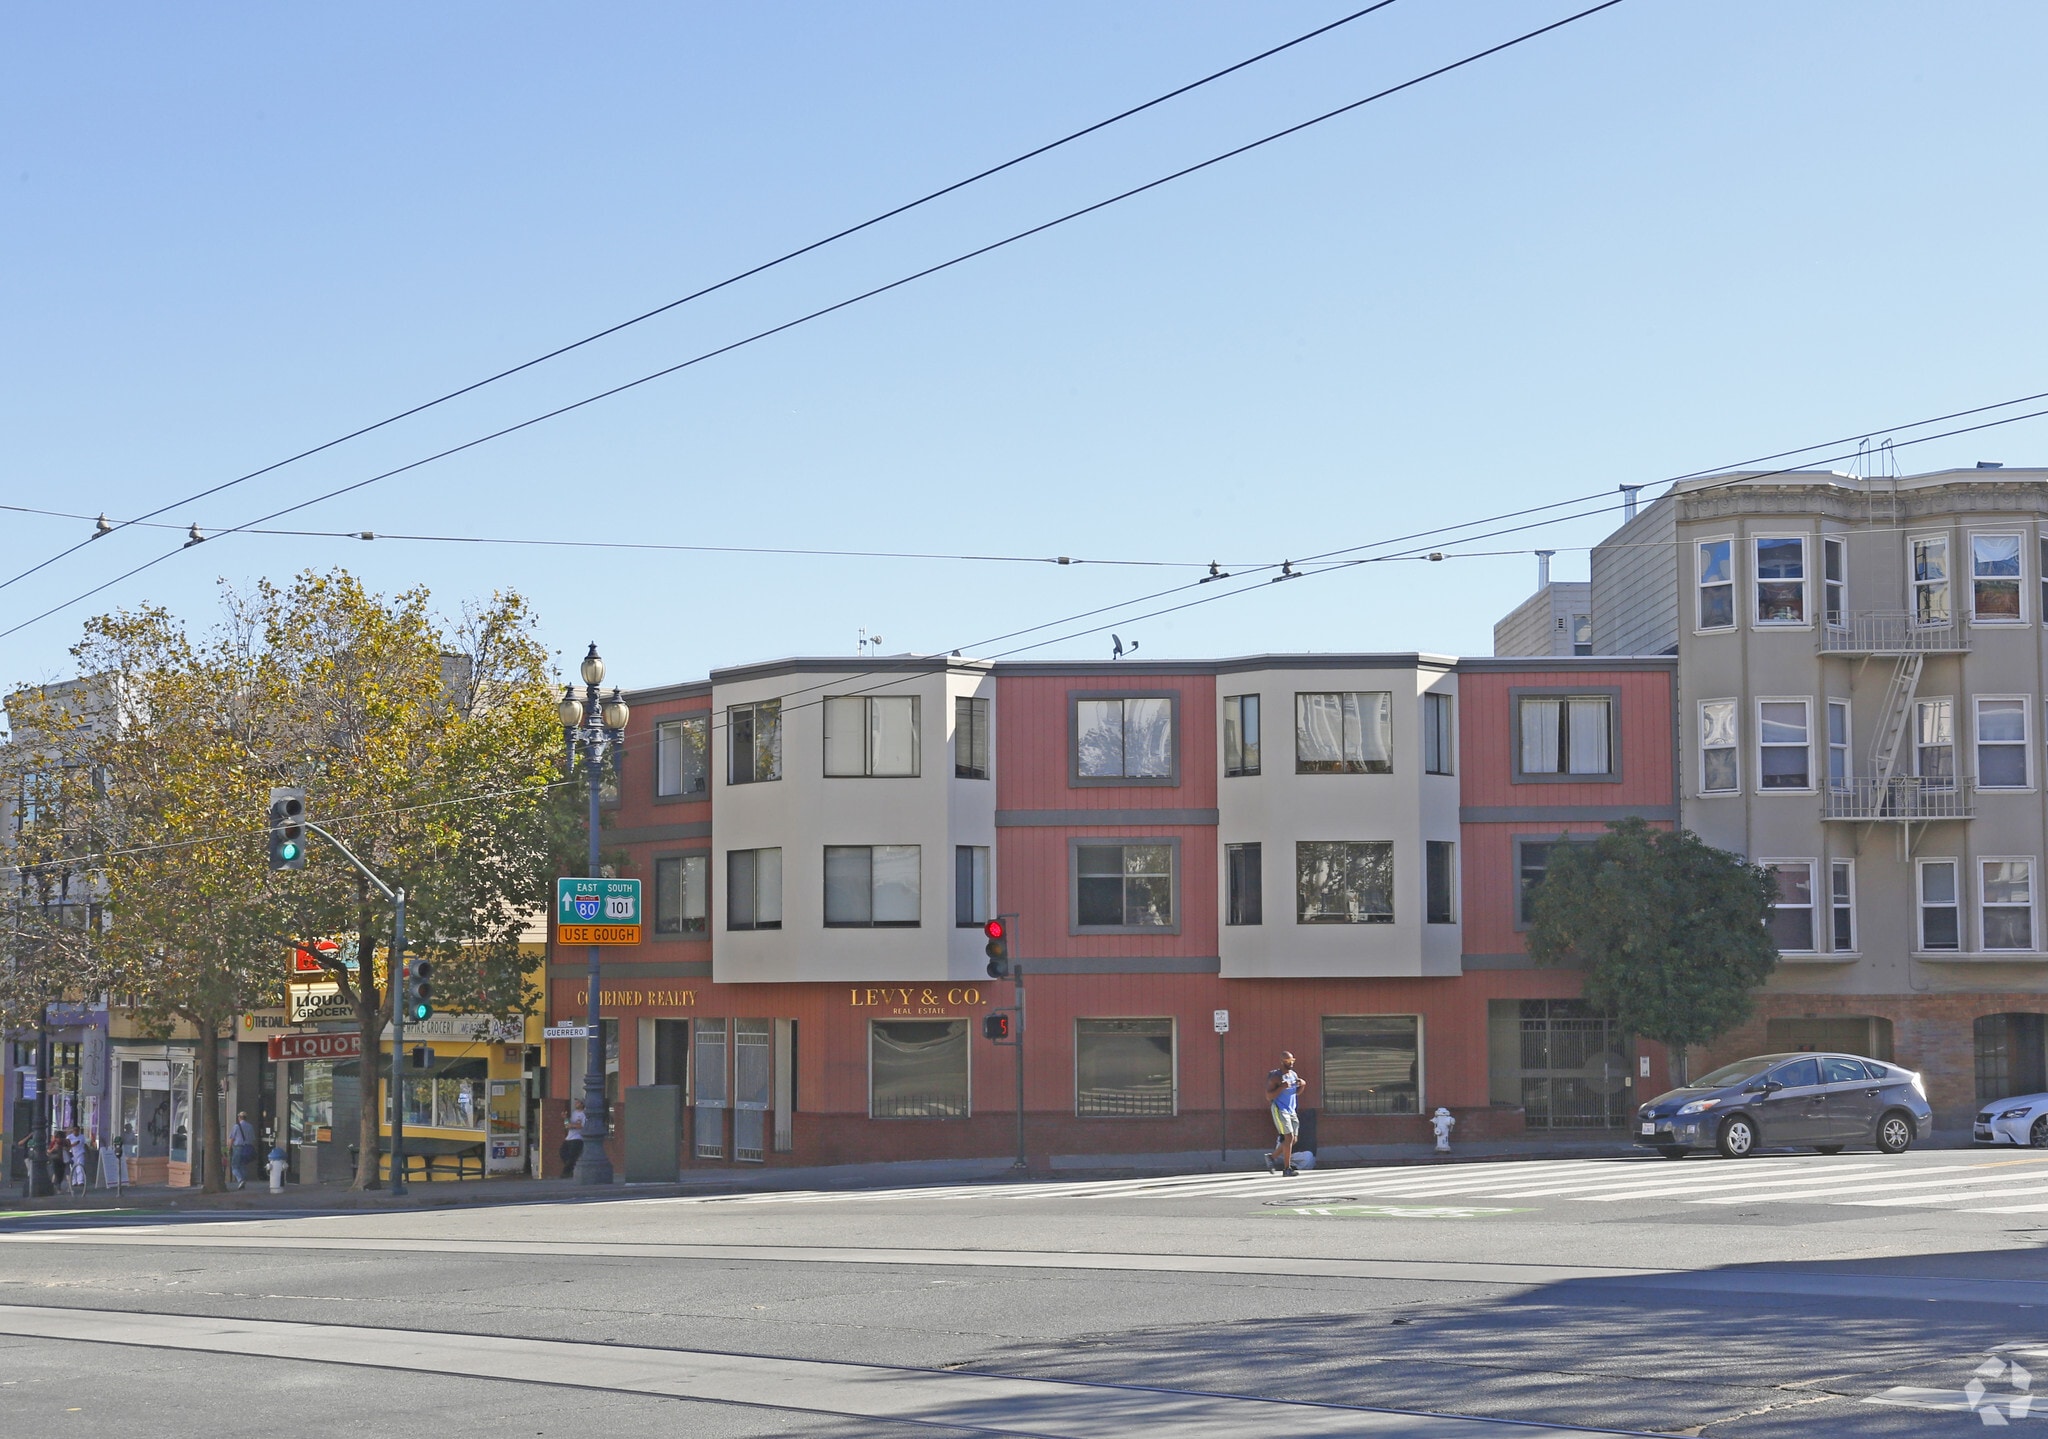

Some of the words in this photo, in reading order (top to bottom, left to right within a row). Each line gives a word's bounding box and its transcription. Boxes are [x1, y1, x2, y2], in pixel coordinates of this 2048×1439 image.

[577, 883, 598, 892] EAST
[607, 884, 633, 893] SOUTH
[579, 903, 596, 916] 80
[612, 901, 629, 914] 101
[564, 928, 588, 941] USE
[593, 928, 634, 941] GOUGH
[648, 990, 697, 1006] REALTY
[850, 988, 914, 1006] LEVY
[920, 988, 940, 1005] &
[947, 988, 987, 1006] CO.
[298, 1007, 354, 1018] GROCERY
[254, 1016, 268, 1028] THE
[426, 1020, 454, 1034] GROCERY
[546, 1029, 584, 1037] GUERRERO
